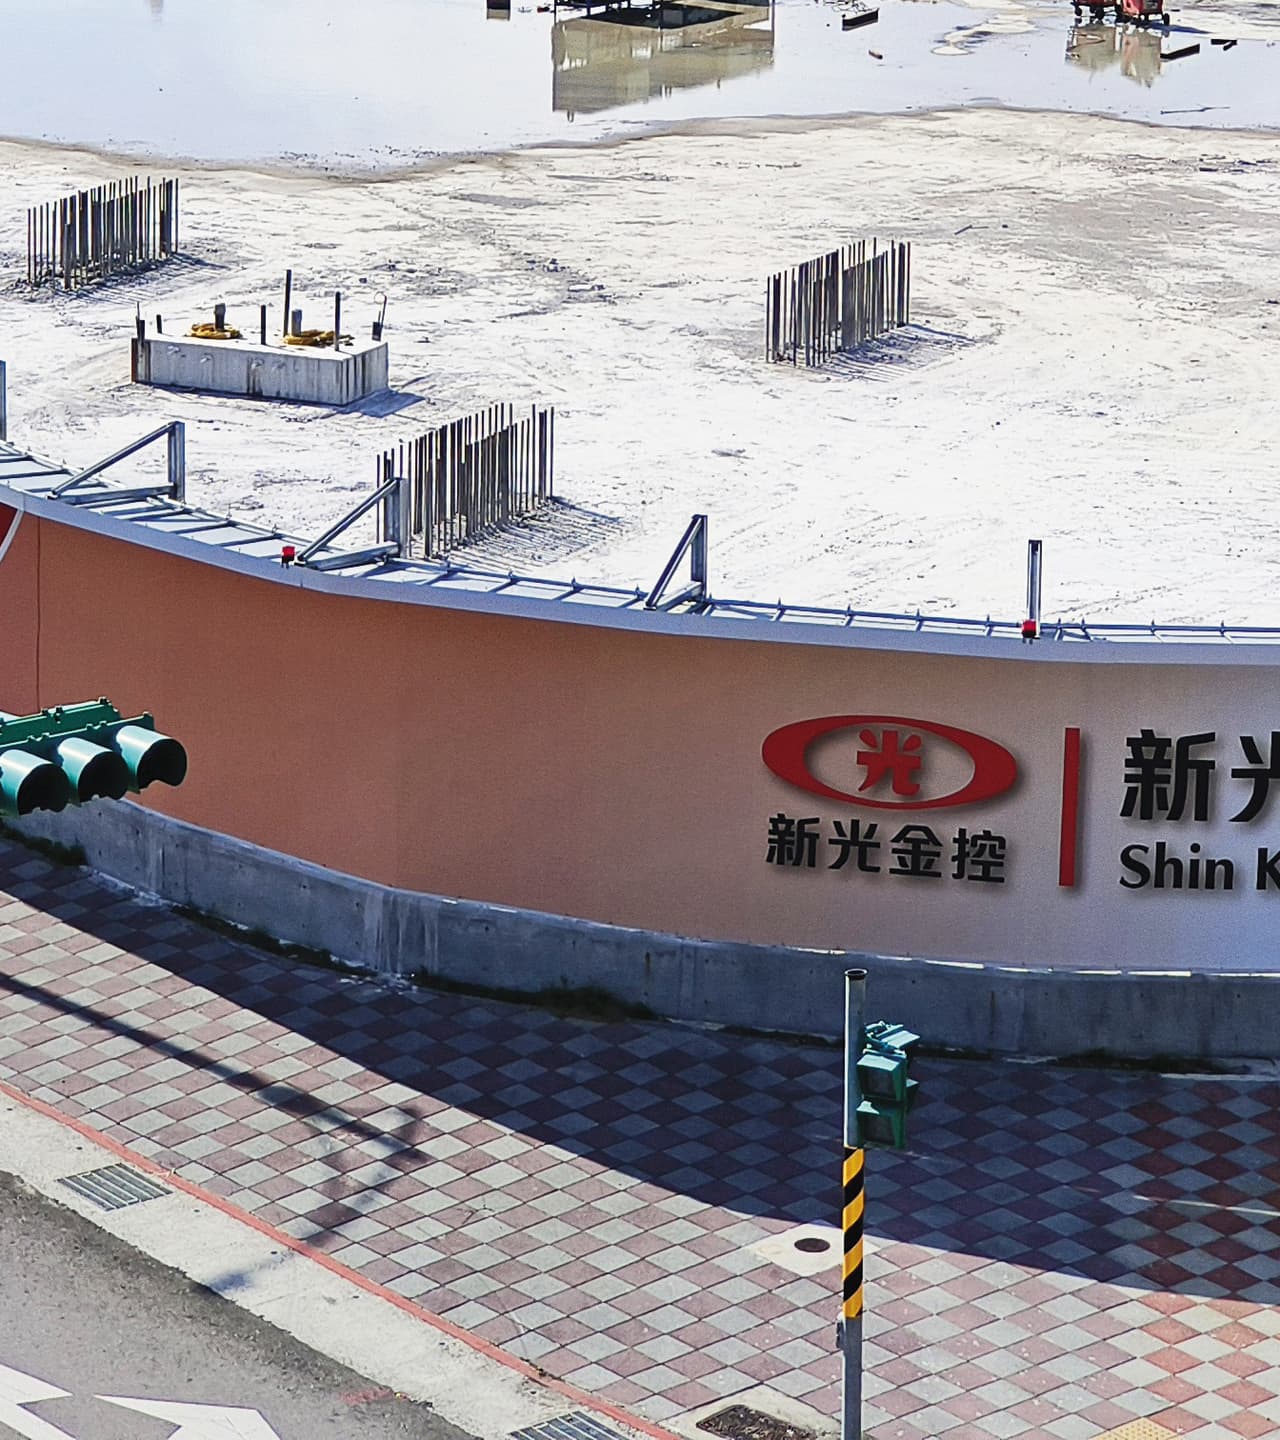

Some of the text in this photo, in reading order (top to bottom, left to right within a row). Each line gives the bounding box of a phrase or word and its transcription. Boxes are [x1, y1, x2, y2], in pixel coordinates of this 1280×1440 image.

[766, 813, 1008, 884] 新光金控
[1120, 842, 1236, 892] Shin
